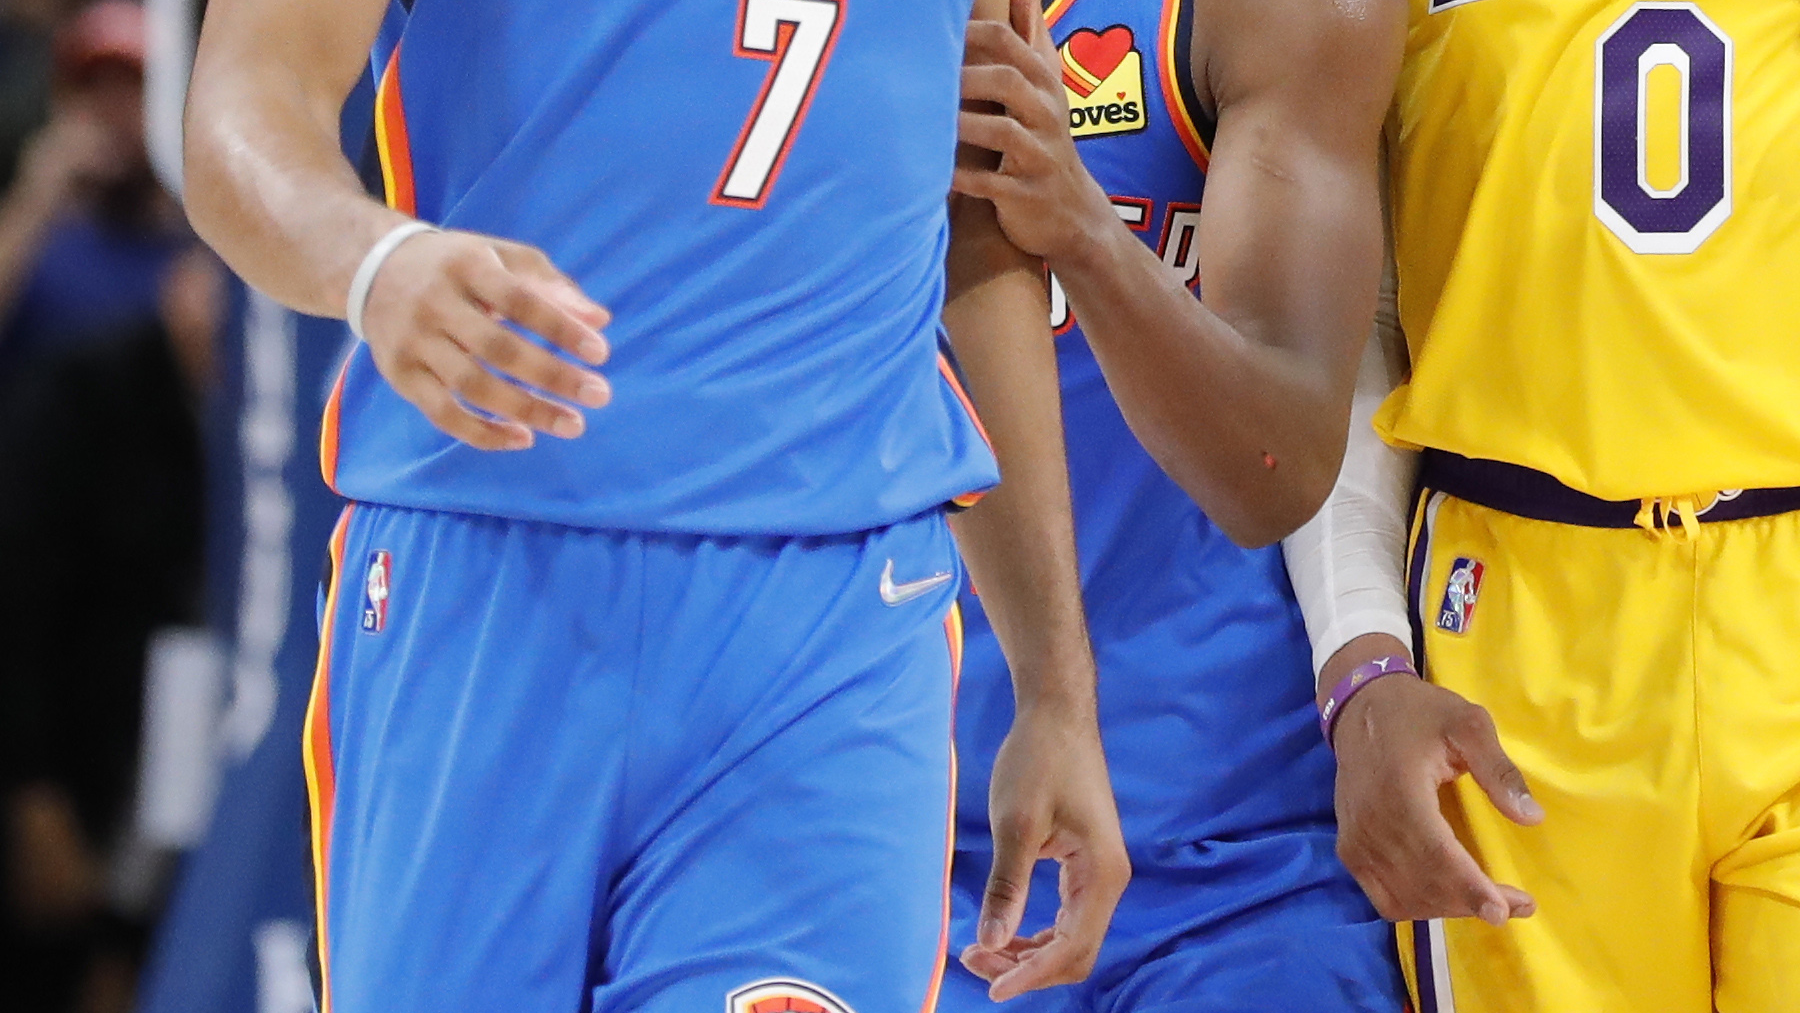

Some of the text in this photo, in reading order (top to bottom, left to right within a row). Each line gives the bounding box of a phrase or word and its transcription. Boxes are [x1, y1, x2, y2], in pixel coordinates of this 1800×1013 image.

[1069, 92, 1140, 128] ove's
[1593, 1, 1733, 255] 0
[1441, 609, 1455, 627] 75
